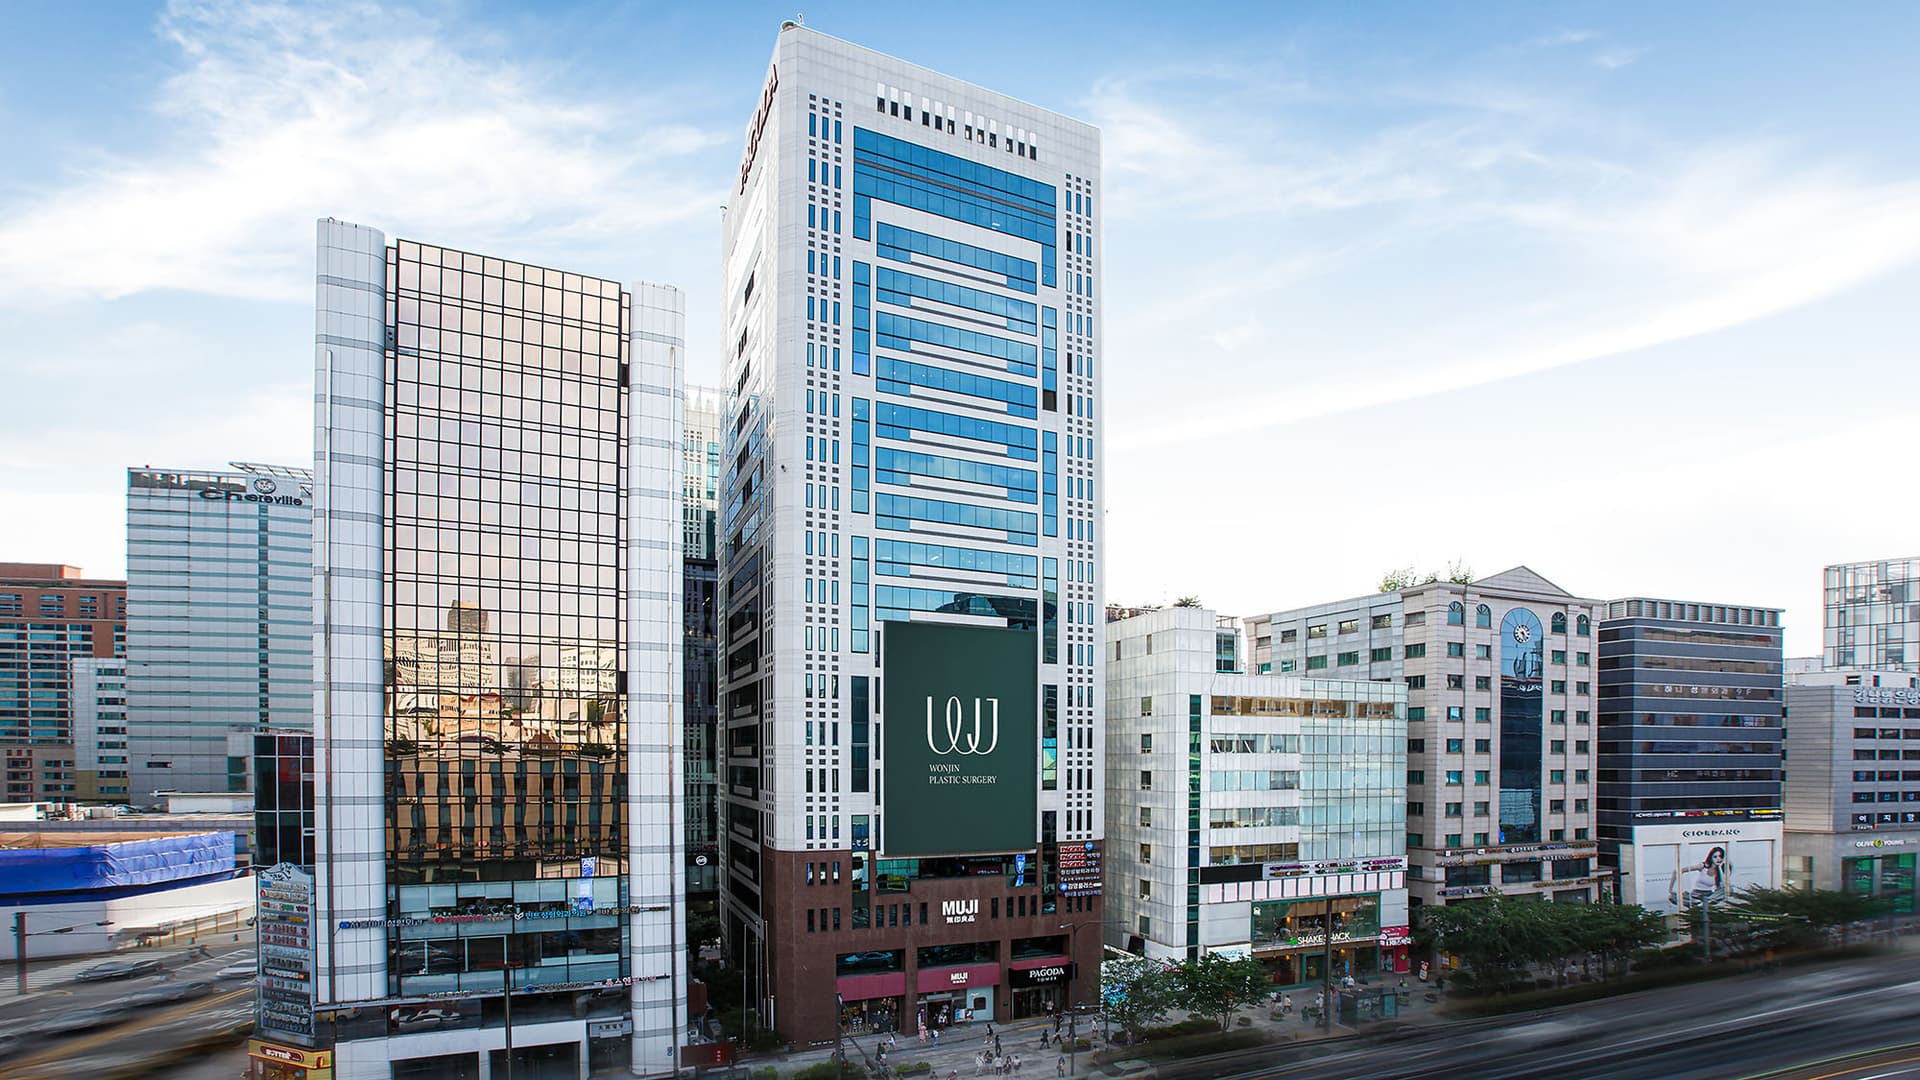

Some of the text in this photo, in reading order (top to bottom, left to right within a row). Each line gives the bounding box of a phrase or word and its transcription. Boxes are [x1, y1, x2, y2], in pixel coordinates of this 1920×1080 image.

[199, 485, 303, 506] Chereville
[929, 763, 960, 774] WONJIN
[929, 775, 997, 785] PLASTIC SURGERY
[1682, 828, 1740, 838] GIORDANO
[1855, 837, 1905, 848] OLIVE YOUNG
[942, 899, 979, 916] MUJI
[1297, 934, 1324, 945] SHAKE
[950, 971, 969, 981] MUJI
[1029, 966, 1065, 979] PAGODA
